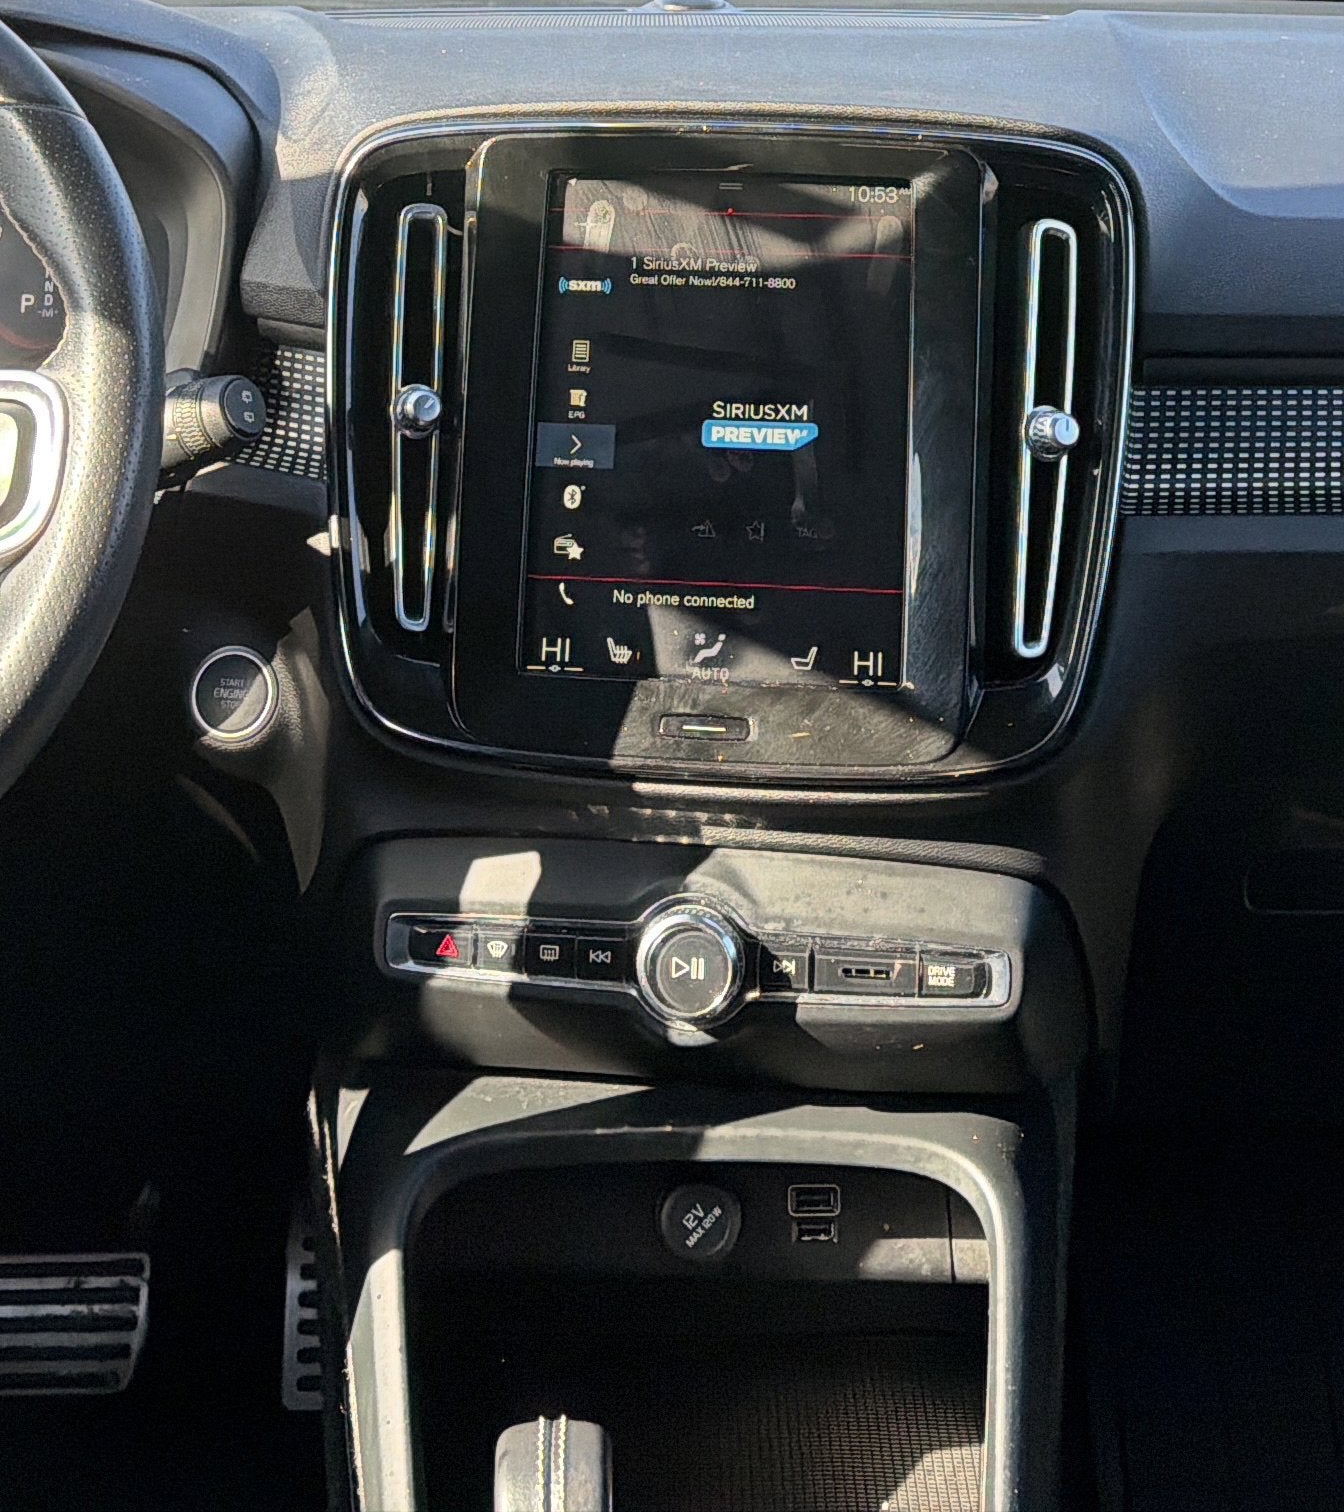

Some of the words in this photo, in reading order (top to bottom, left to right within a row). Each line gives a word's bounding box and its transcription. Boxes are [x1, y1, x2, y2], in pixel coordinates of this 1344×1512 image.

[849, 186, 897, 203] 10:53
[631, 257, 637, 270] 1
[643, 257, 702, 271] SiriusXM
[706, 258, 758, 273] Preview
[630, 274, 658, 285] Great
[660, 274, 686, 286] Offer
[20, 294, 35, 314] P
[712, 400, 809, 421] SIRIUSXM
[711, 426, 809, 445] PREVIEW
[613, 589, 634, 605] No
[636, 591, 680, 608] phone
[683, 593, 755, 609] connected
[541, 637, 571, 662] HI
[853, 650, 883, 677] HI
[691, 667, 730, 681] AUTO
[928, 965, 956, 977] DRIVE
[928, 976, 955, 987] MODE
[682, 1203, 704, 1230] 12V
[685, 1226, 706, 1248] MAX
